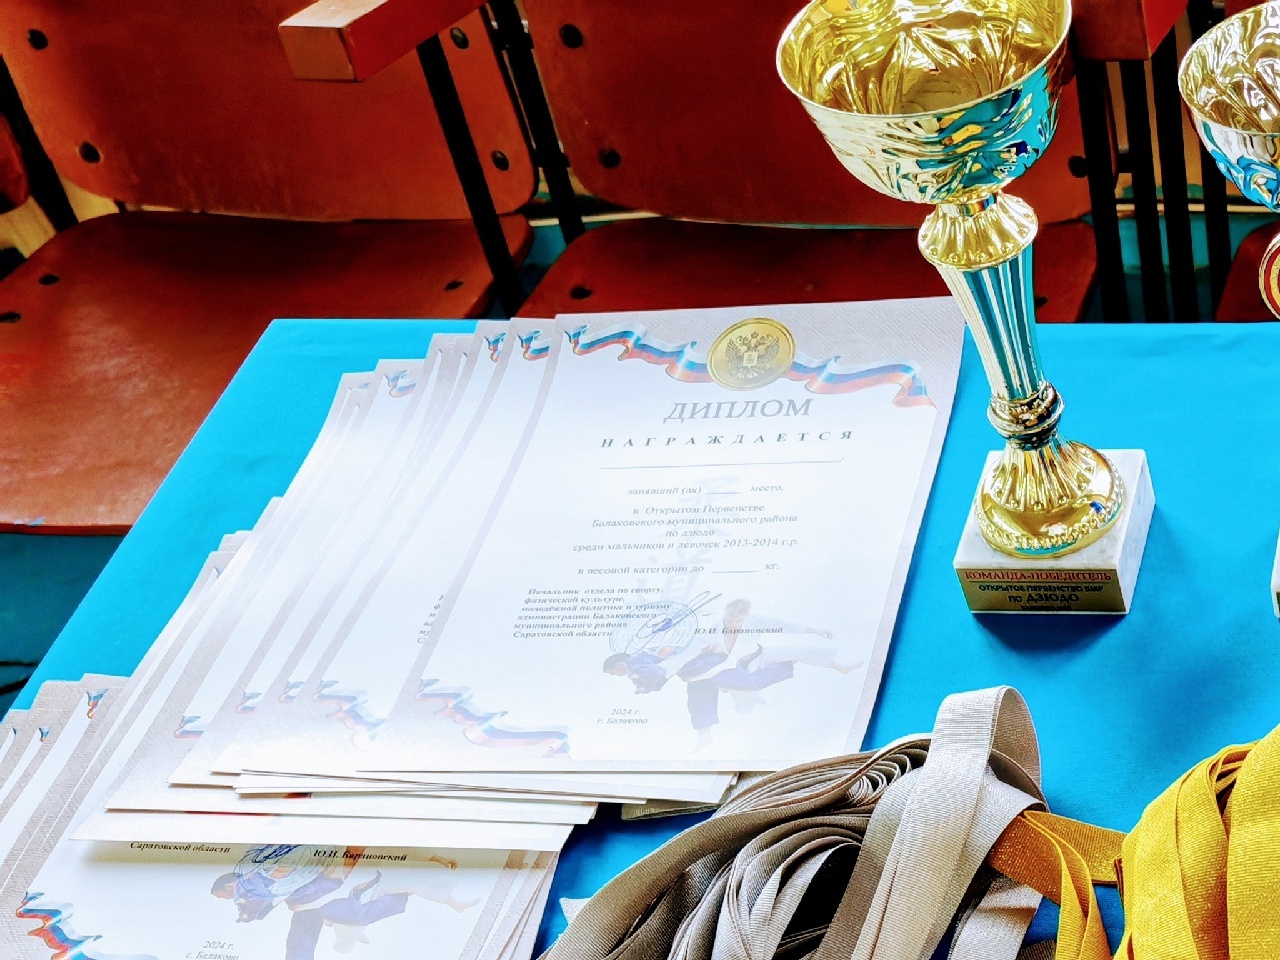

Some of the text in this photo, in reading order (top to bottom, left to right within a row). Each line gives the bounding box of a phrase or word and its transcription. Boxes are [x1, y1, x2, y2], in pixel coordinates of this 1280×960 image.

[662, 398, 813, 425] ДИПЛОМ
[645, 505, 700, 516] Открытом
[702, 503, 765, 514] Первенстве
[591, 519, 665, 529] Балаковского
[666, 516, 758, 528] муниципального
[665, 528, 716, 539] по дзюдо
[572, 543, 605, 554] среди
[607, 543, 665, 552] мальчиков
[676, 541, 721, 551] девочек
[722, 538, 779, 548] 2013-2014
[586, 565, 631, 575] весовой
[633, 565, 688, 577] категории
[965, 571, 1112, 582] КОМАНДА-ПОБЕДИТЕЛЬ
[979, 584, 1025, 592] ОТКРЫТОЕ
[1027, 584, 1084, 593] ПЕРВЕНСТВО
[1026, 592, 1080, 604] ДЗЮДО
[609, 708, 632, 716] 2024
[129, 841, 192, 853] Саратовской
[193, 844, 231, 854] области
[341, 850, 407, 862] Барановский
[202, 941, 226, 949] 2024
[195, 951, 240, 960] Балаково
